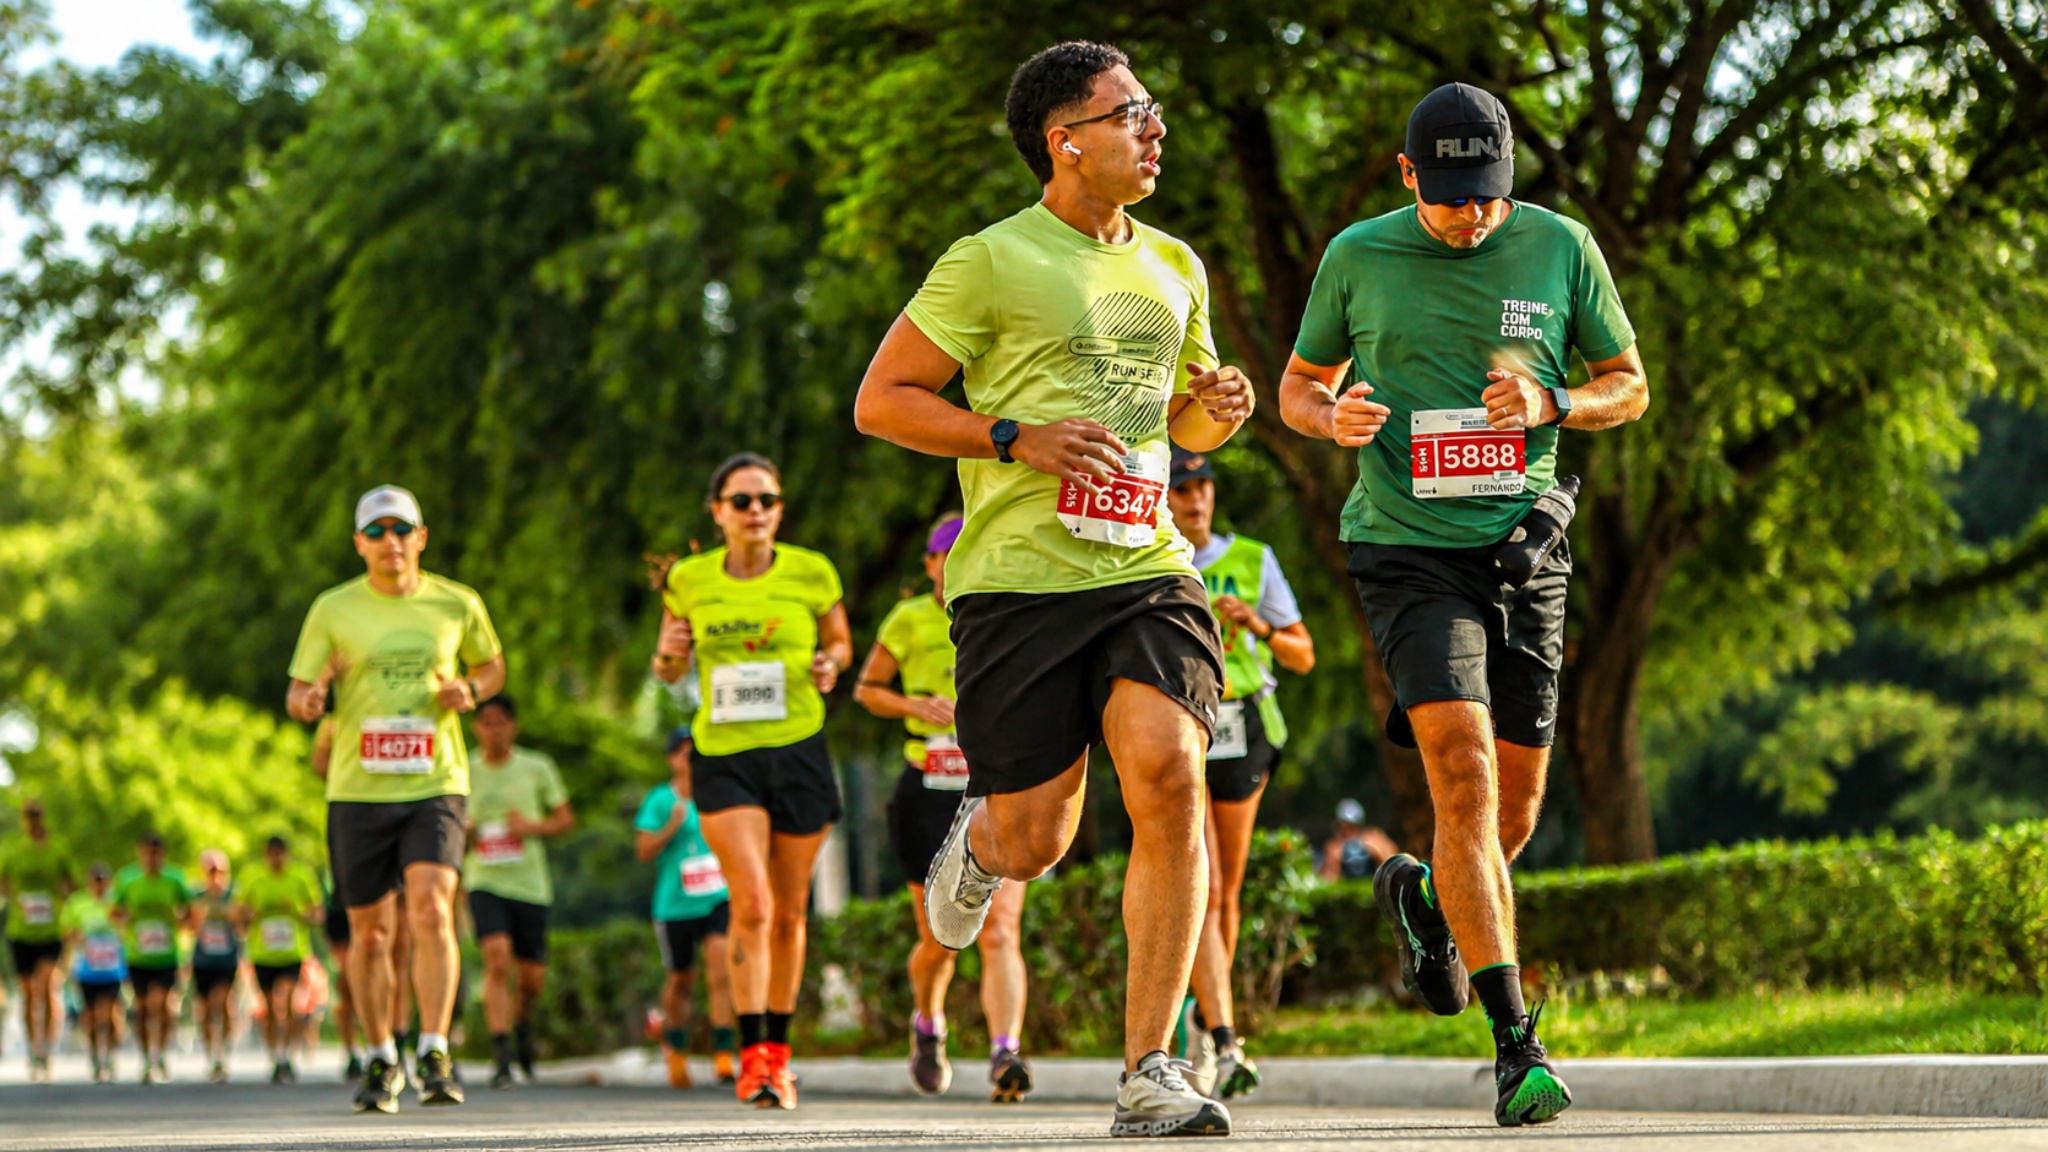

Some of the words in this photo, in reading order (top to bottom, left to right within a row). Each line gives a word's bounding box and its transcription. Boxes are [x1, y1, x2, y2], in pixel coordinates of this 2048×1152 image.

[1436, 136, 1494, 158] RUN
[1501, 299, 1548, 315] TREINE
[1501, 312, 1531, 326] COM
[1500, 325, 1543, 340] CORPO
[1111, 363, 1138, 377] RUN
[1443, 442, 1517, 470] 5888
[1471, 483, 1522, 494] FERNANDO
[1094, 485, 1156, 519] 6347
[381, 735, 429, 758] 4071
